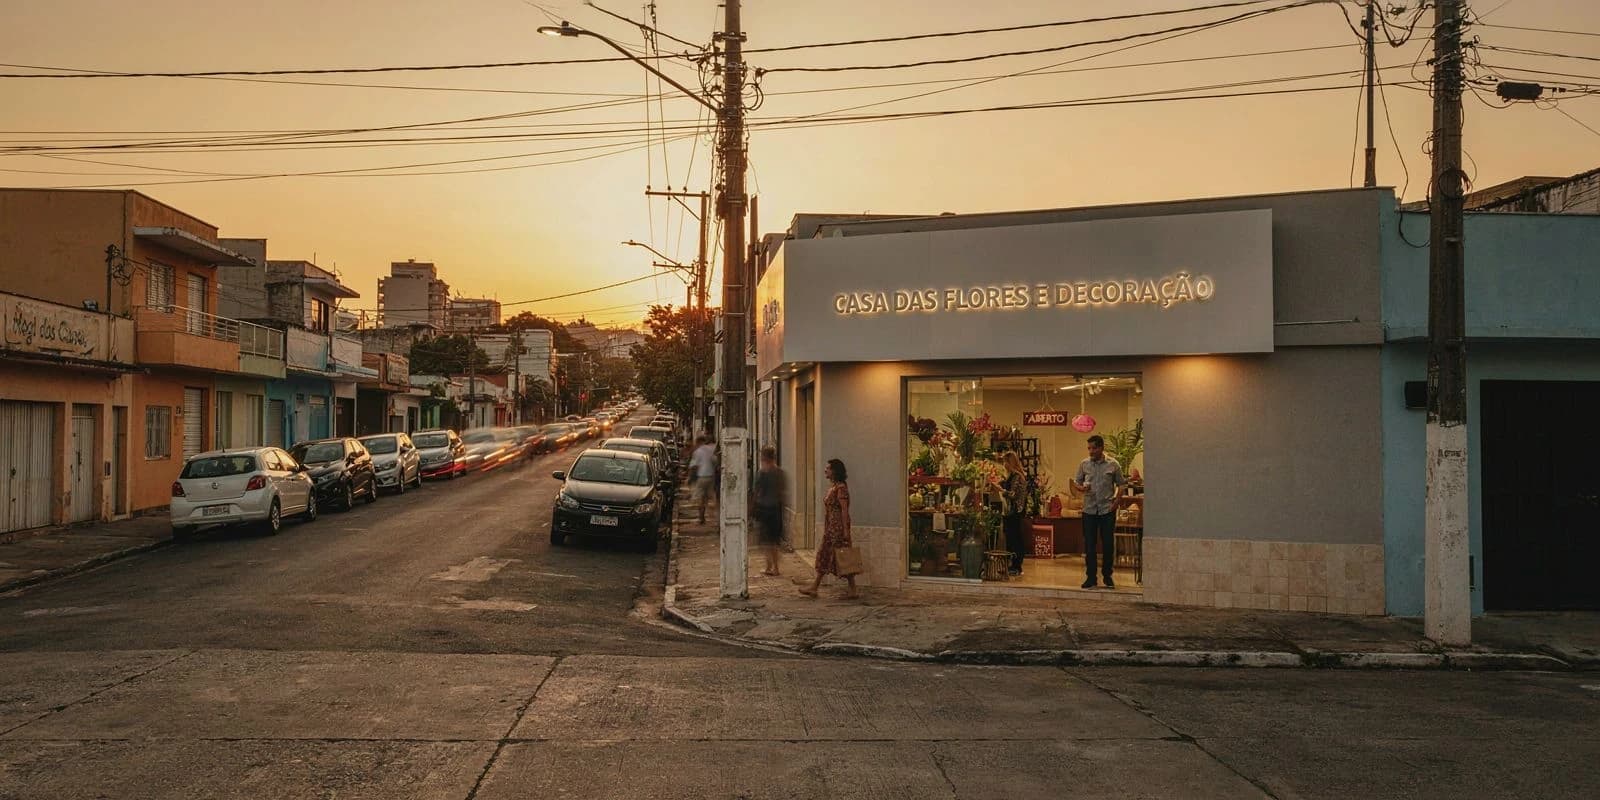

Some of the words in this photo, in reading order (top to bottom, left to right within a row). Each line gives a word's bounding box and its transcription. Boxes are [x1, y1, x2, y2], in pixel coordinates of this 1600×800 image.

[834, 291, 890, 315] CASA
[894, 288, 938, 313] DAS
[943, 285, 1029, 311] FLORES
[1035, 284, 1050, 308] E
[1054, 272, 1215, 308] DECORAÇÃO
[1027, 413, 1065, 424] ABERTO
